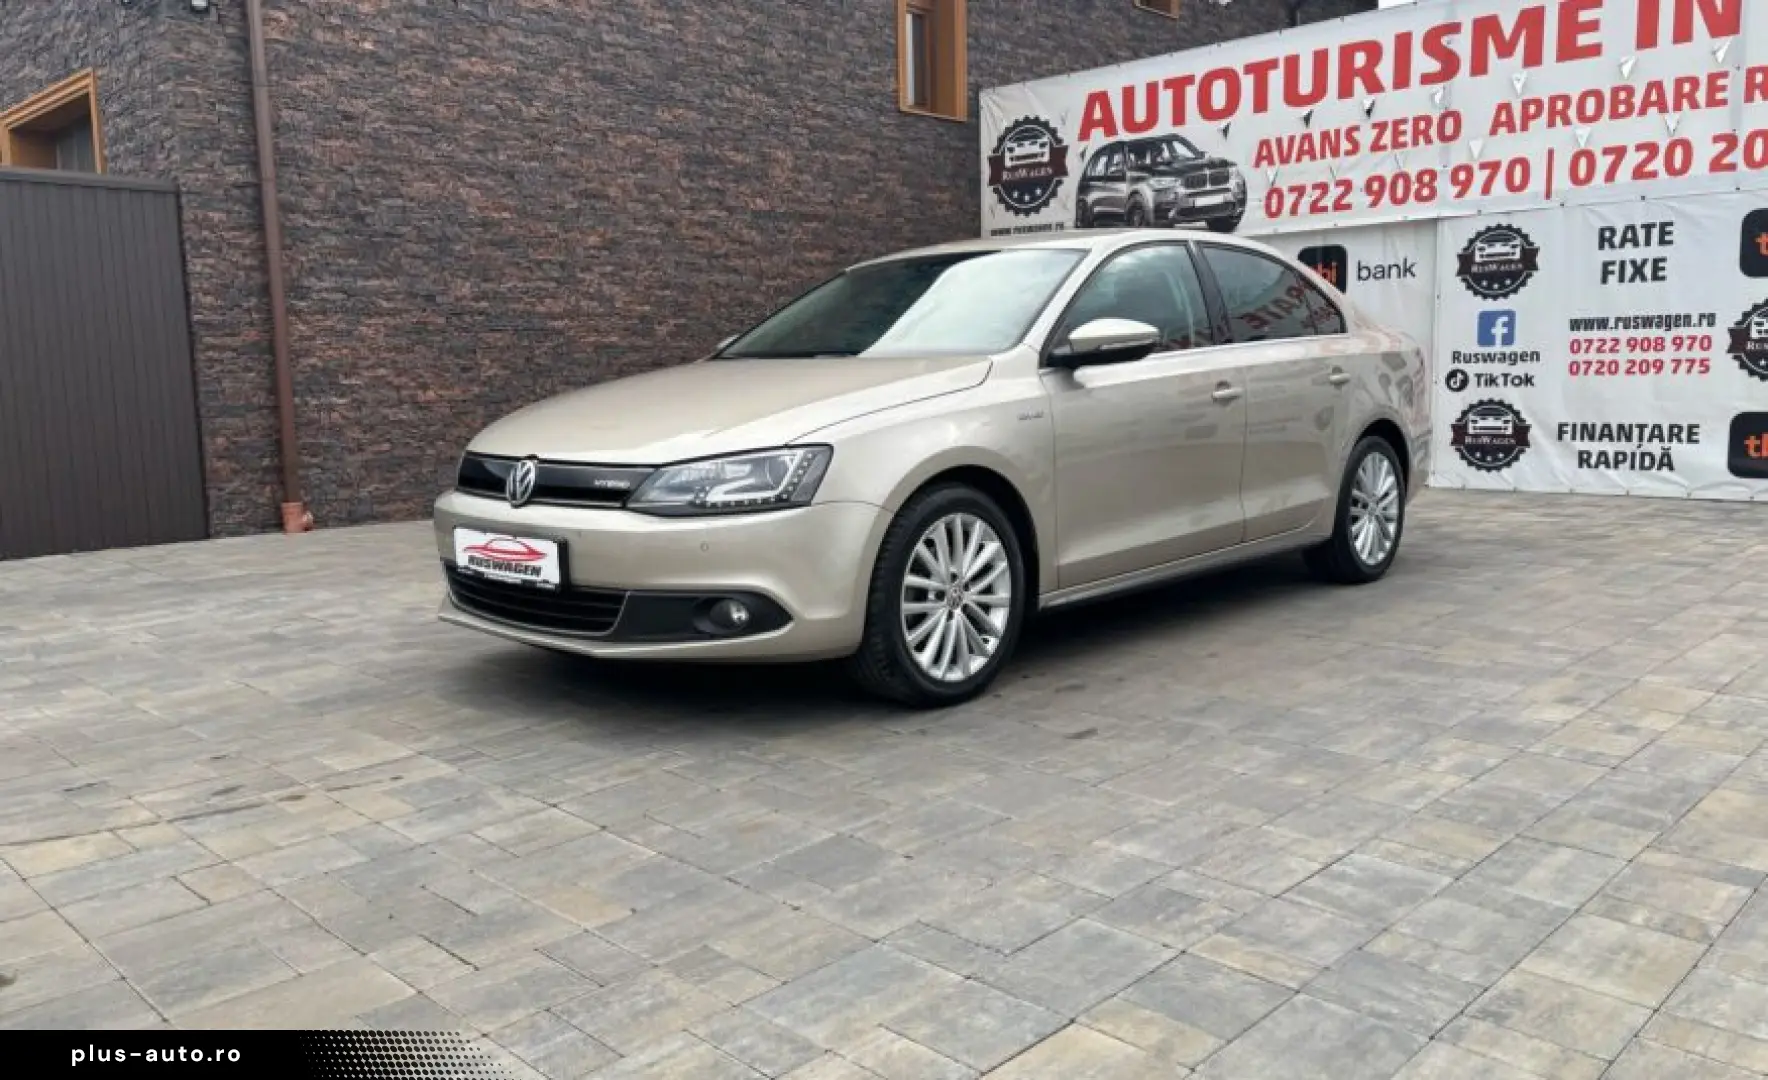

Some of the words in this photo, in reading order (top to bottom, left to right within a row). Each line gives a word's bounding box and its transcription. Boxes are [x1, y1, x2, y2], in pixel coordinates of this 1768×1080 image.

[1078, 0, 1604, 142] AUTOTURISME
[1635, 0, 1742, 50] IN
[1253, 126, 1361, 169] AVANS
[1369, 110, 1463, 153] ZERO
[1489, 71, 1729, 136] APROBARE
[1264, 179, 1353, 219] 0722
[1364, 169, 1438, 208] 908
[1450, 157, 1531, 199] 970
[1569, 138, 1694, 187] 0720
[1598, 221, 1674, 251] RATE
[1357, 256, 1417, 282] bank
[1600, 257, 1668, 285] FIXE
[1569, 312, 1716, 332] www.ruswagen.ro
[1569, 338, 1621, 354] 0722
[1627, 336, 1665, 352] 908
[1671, 334, 1712, 352] 970
[1452, 350, 1541, 366] Ruswagen
[1569, 360, 1619, 376] 0720
[1625, 359, 1664, 375] 209
[1671, 358, 1711, 374] 775
[1474, 372, 1535, 388] TikTok
[1577, 446, 1675, 472] RAPIDĂ
[467, 555, 542, 578] RUSWAGEN
